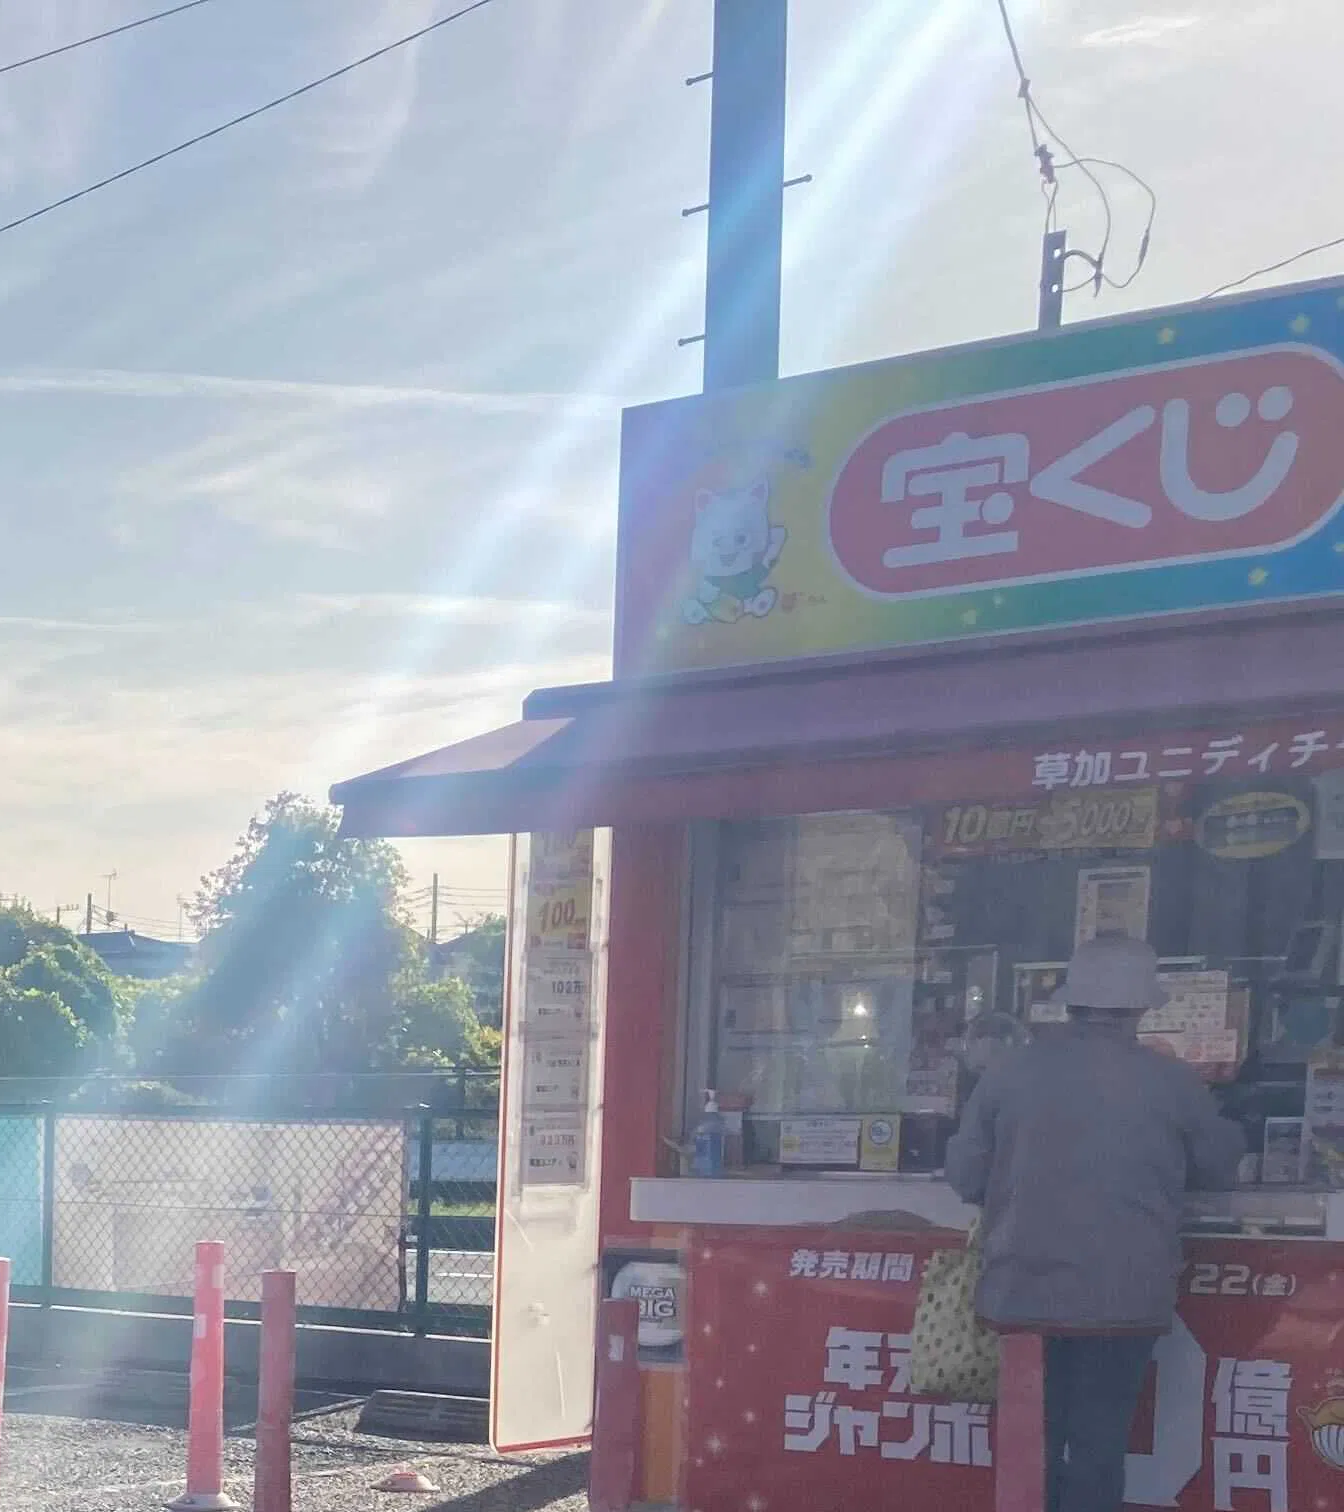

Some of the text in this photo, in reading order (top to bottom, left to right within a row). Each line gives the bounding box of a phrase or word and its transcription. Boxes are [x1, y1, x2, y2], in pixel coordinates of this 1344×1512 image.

[880, 386, 1300, 569] 宝くじ
[1031, 730, 1344, 790] 草加ユニディチ
[629, 1286, 676, 1298] MEGA
[789, 1249, 914, 1282] 発売期間
[783, 1391, 994, 1468] ジャンボ
